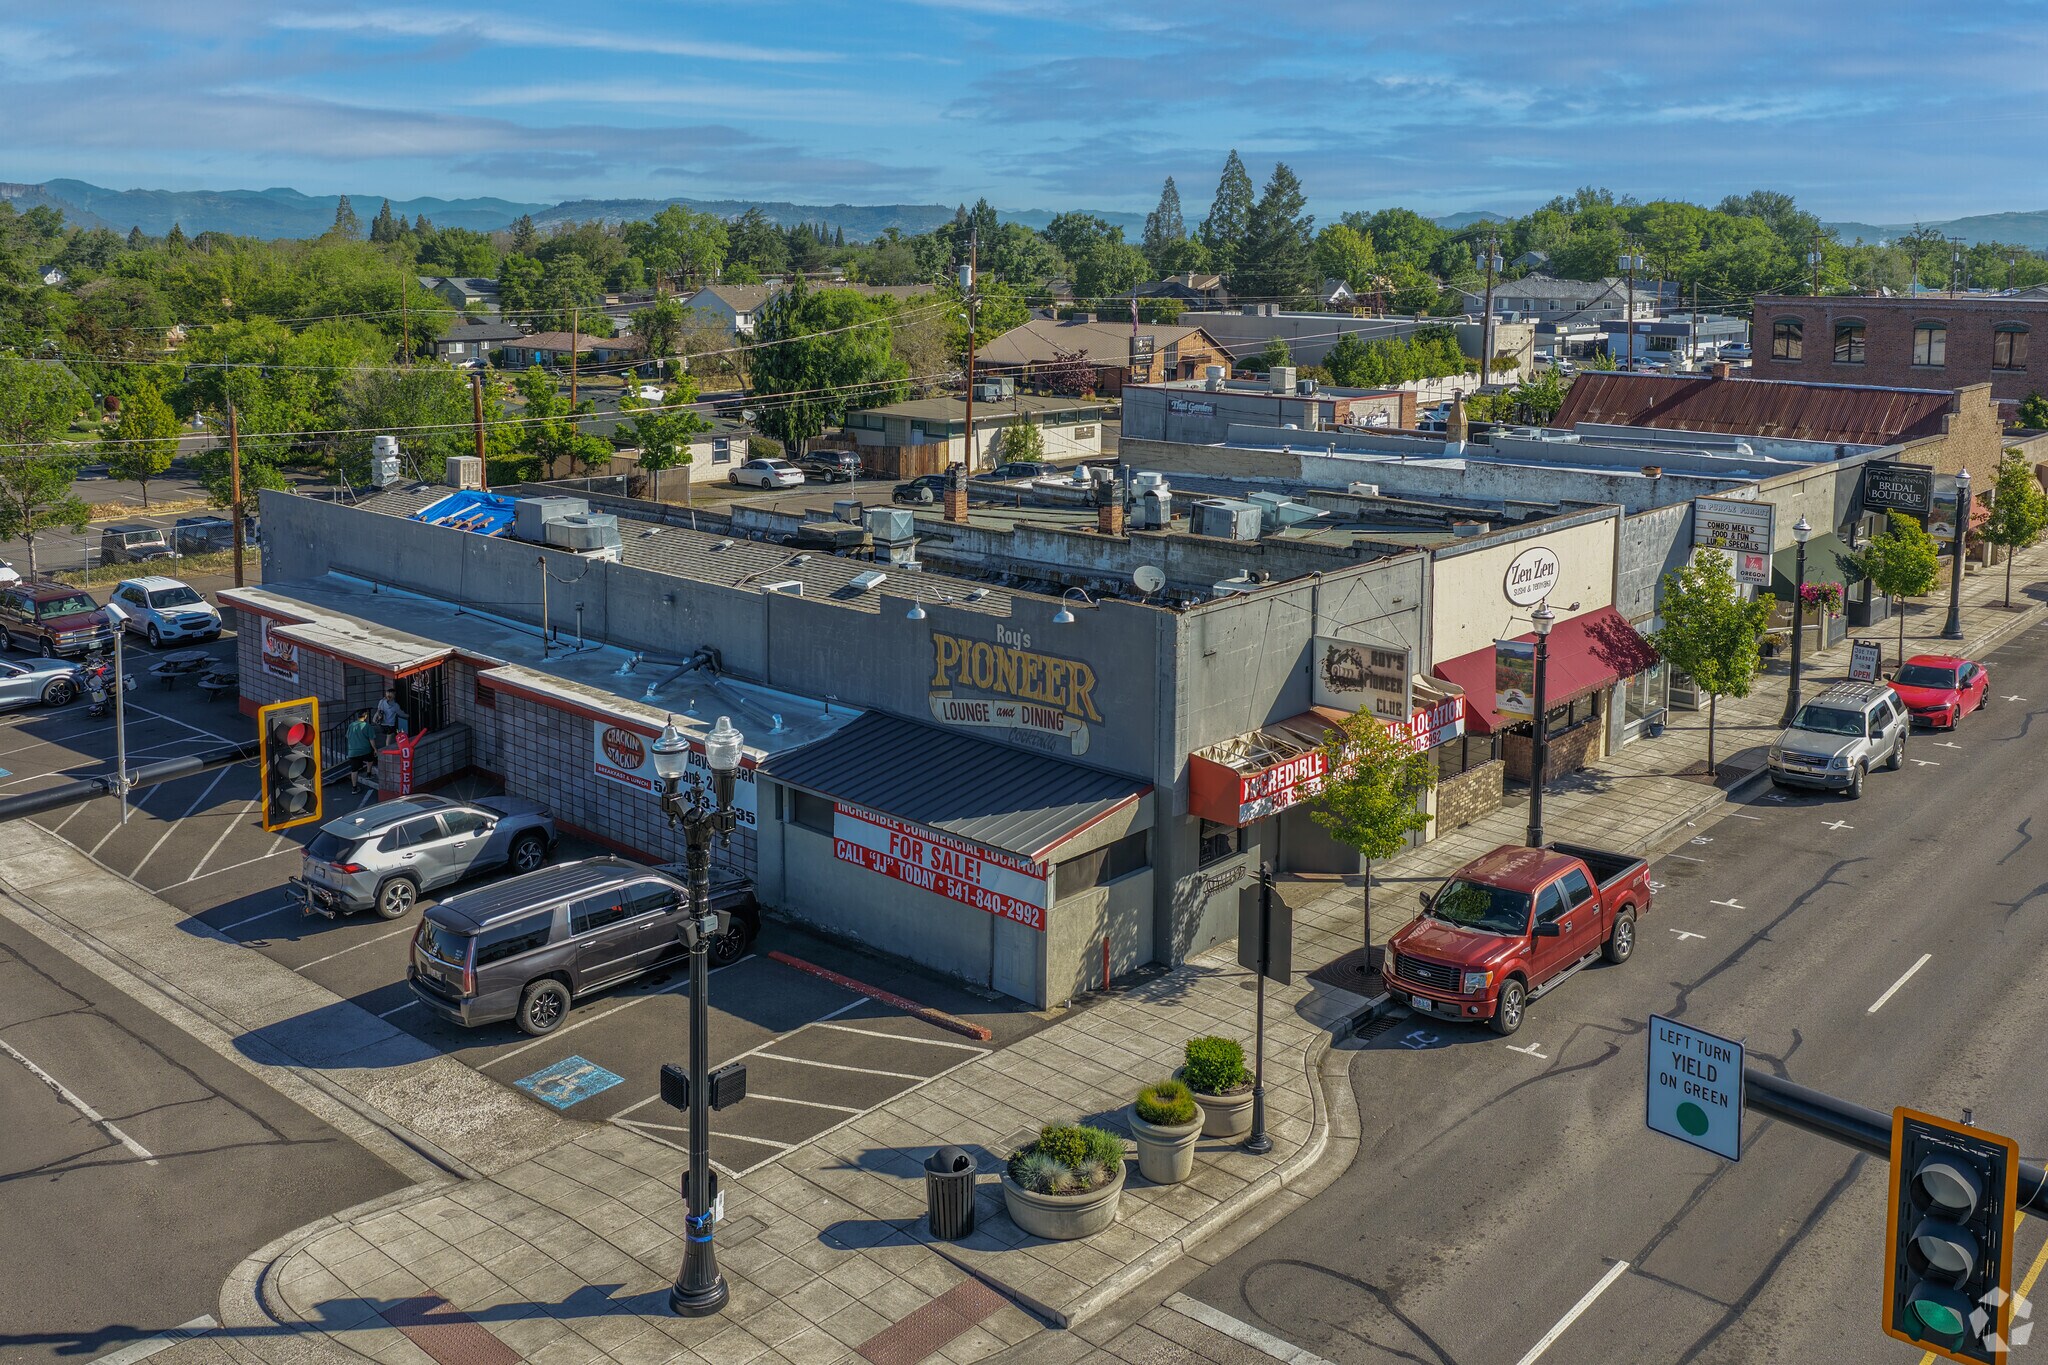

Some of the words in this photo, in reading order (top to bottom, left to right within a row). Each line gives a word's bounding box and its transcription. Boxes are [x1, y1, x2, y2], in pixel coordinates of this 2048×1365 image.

[1871, 489, 1922, 504] BOUTIQUE
[1879, 481, 1916, 493] BRIDAL
[1707, 521, 1730, 531] COMBO
[1732, 524, 1755, 534] MEALS
[1712, 529, 1728, 539] FOOD
[1737, 532, 1750, 541] FUN
[1728, 540, 1759, 551] SPECIALS
[1511, 563, 1532, 585] Zen
[1534, 557, 1554, 579] Zen
[1740, 570, 1766, 578] OREGON
[996, 623, 1032, 650] Roy's
[1370, 650, 1404, 672] ROY'S
[931, 633, 1103, 723] PIONEER
[1853, 669, 1871, 680] OPEN
[942, 701, 990, 723] LOUNGE
[996, 706, 1015, 718] and
[1021, 705, 1064, 732] DINING
[1376, 698, 1402, 717] CLUB
[1243, 752, 1323, 802] INCREDIBLE
[1411, 697, 1463, 737] LOCATION
[401, 747, 411, 795] OPEN
[598, 766, 626, 779] BREAKFAST
[631, 777, 649, 787] LUNCH
[736, 767, 755, 784] eek
[1272, 791, 1289, 809] FOR
[837, 802, 900, 830] INCREDIBLE
[903, 823, 981, 857] COMMERCIAL
[889, 832, 924, 866] FOR
[930, 846, 982, 885] SALE!
[836, 841, 866, 866] CALL
[897, 860, 937, 891] TODAY
[947, 879, 1040, 928] 541-840-2992
[1659, 1027, 1691, 1050] LEFT
[1697, 1039, 1731, 1064] TURN
[1672, 1051, 1718, 1083] YIELD
[1660, 1072, 1677, 1089] ON
[1684, 1081, 1728, 1108] GREEN
